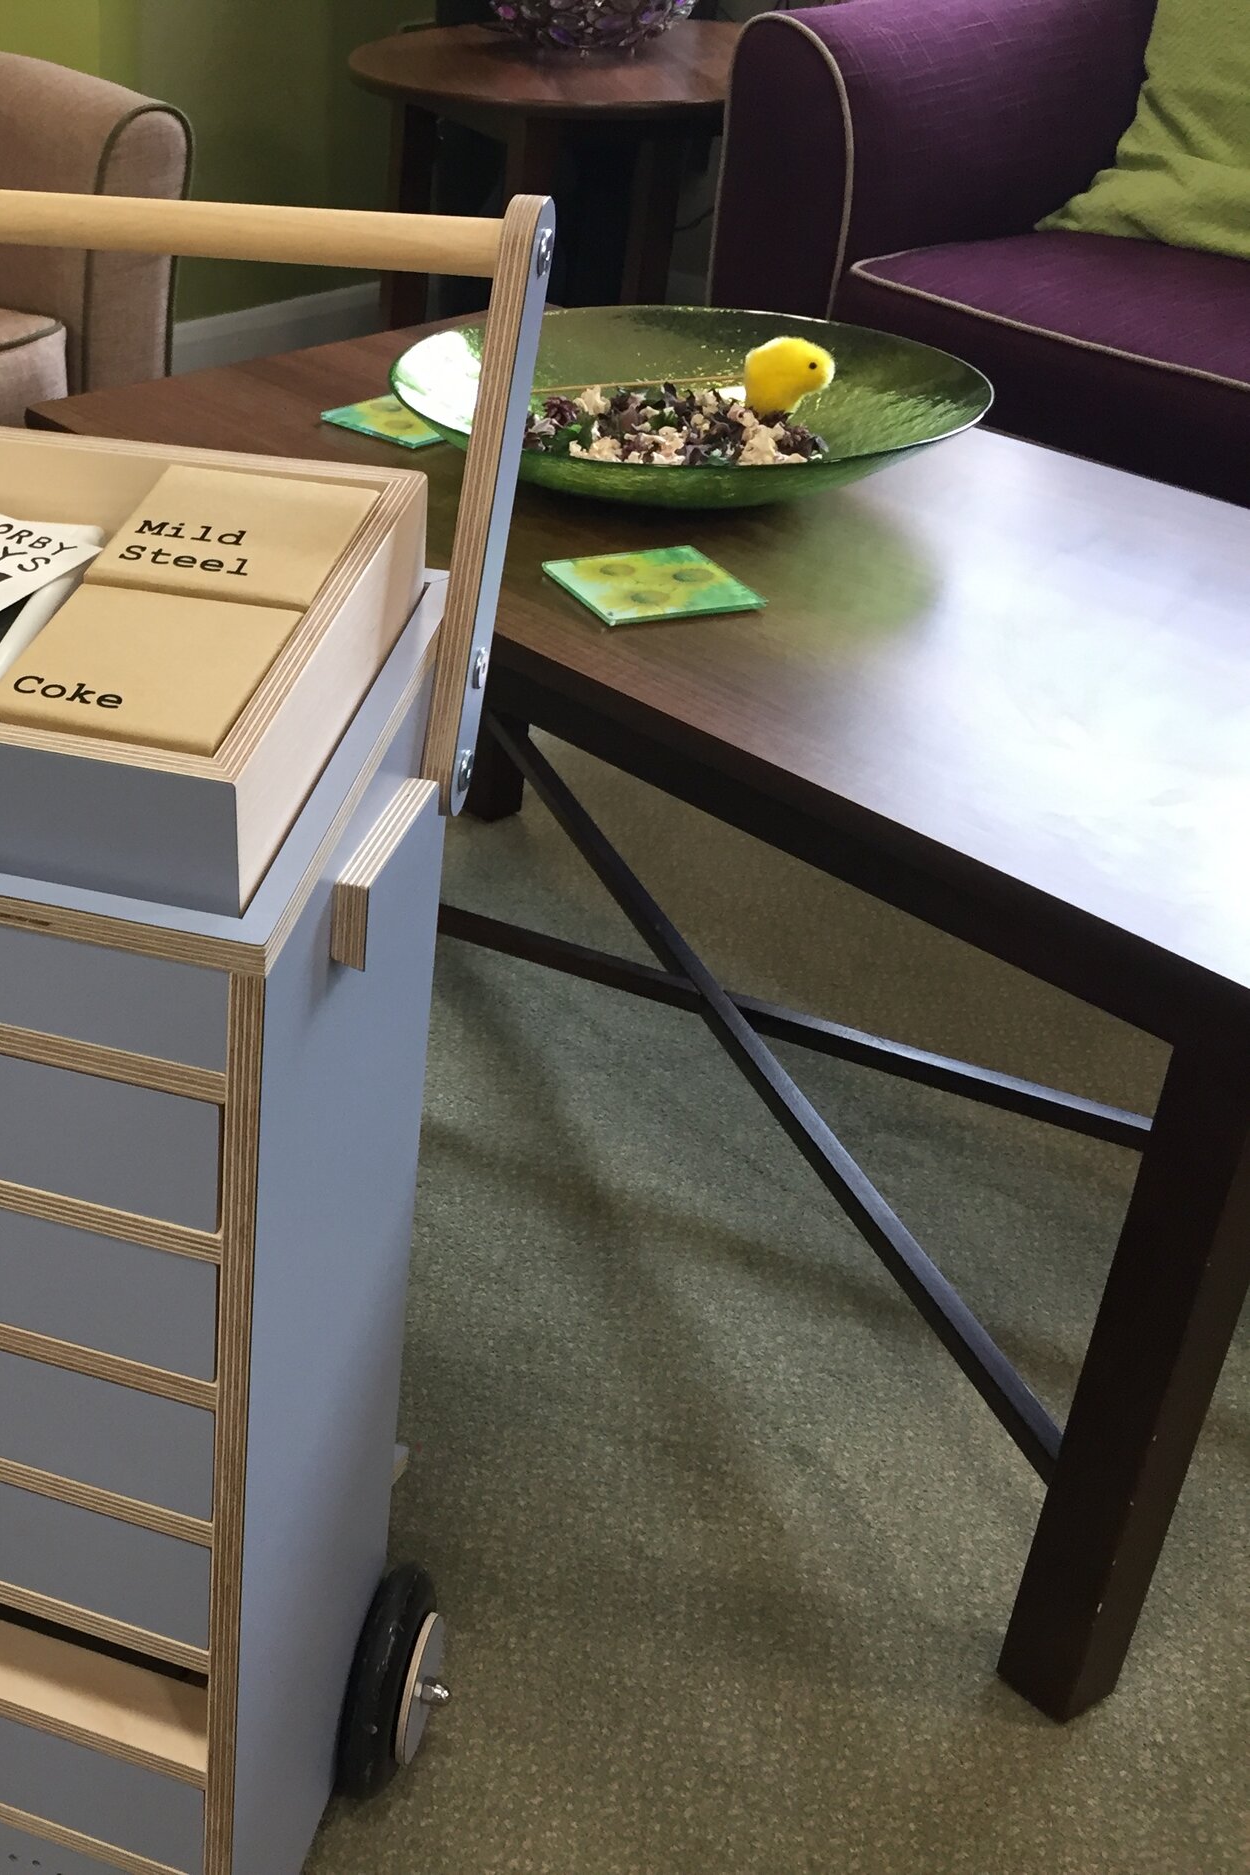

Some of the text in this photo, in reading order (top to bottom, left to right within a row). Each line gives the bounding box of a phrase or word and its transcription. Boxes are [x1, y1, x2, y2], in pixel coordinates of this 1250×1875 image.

[134, 519, 247, 546] Mild
[118, 545, 249, 576] Steel
[13, 675, 123, 709] Coke
